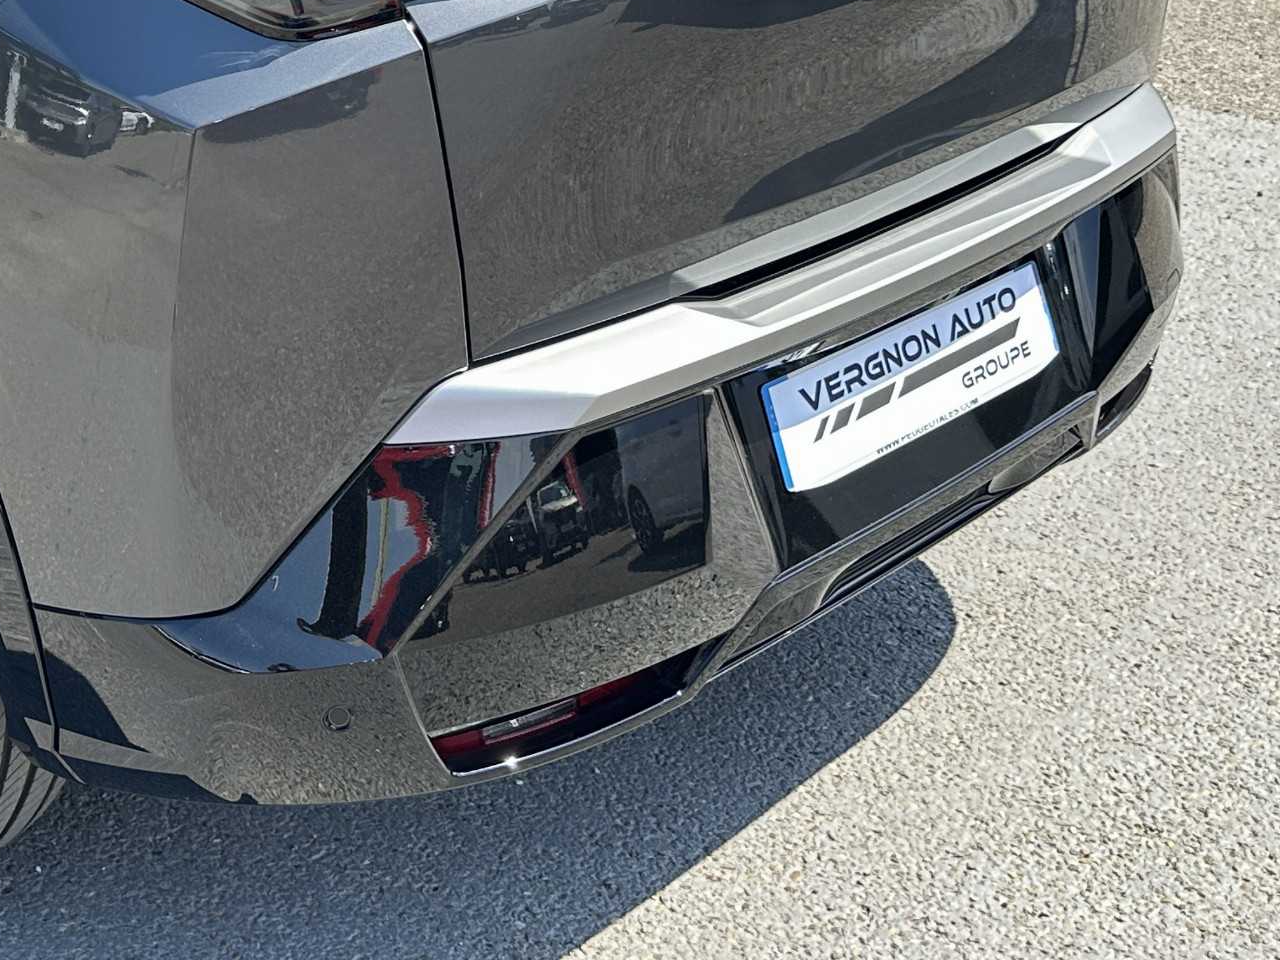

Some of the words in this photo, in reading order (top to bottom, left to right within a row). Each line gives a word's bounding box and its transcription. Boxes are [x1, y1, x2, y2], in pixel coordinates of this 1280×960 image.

[798, 323, 942, 411] VERGNON
[950, 286, 1017, 343] AUTO
[961, 339, 1032, 389] GROUPE
